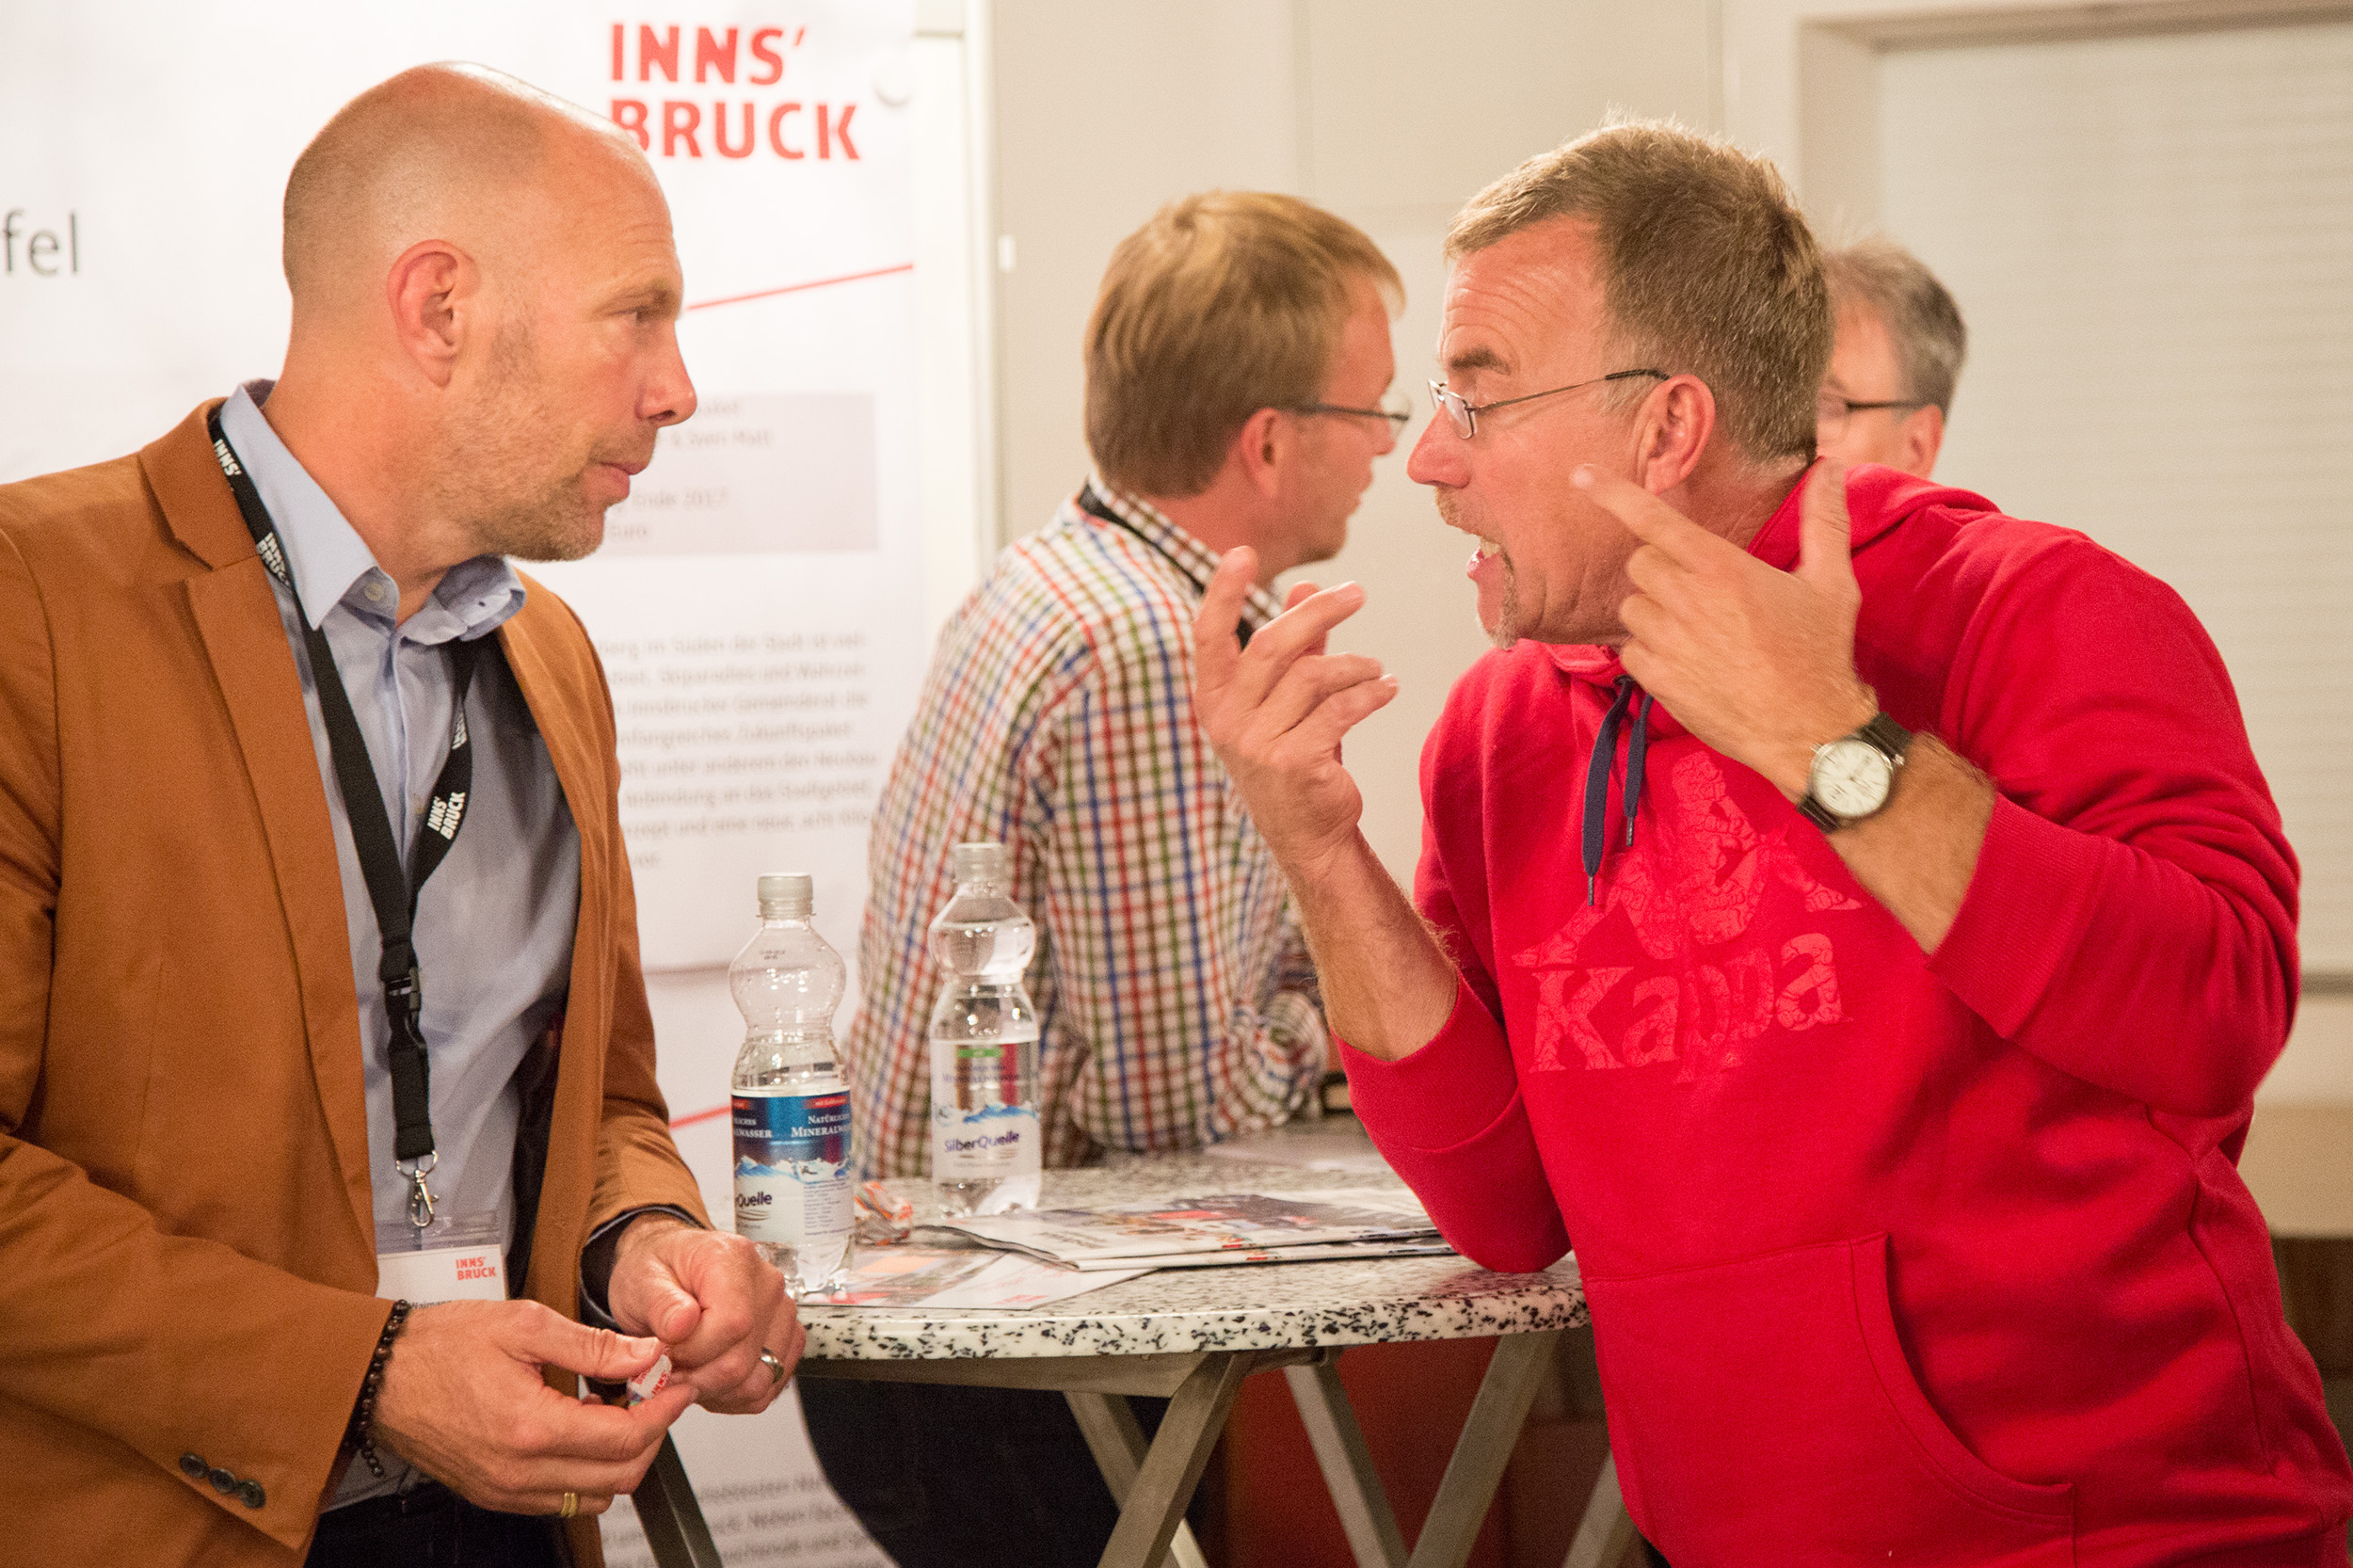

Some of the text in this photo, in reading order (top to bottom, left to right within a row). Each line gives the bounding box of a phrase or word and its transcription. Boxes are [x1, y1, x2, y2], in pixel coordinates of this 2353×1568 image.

[613, 24, 805, 86] INNS'
[612, 99, 859, 160] BRUCK
[2, 208, 78, 277] fel
[427, 796, 447, 831] INNS'
[440, 792, 466, 840] BRUCK
[1529, 931, 1853, 1083] Kappa
[736, 1190, 773, 1208] Quelle
[457, 1266, 496, 1281] BRUCK
